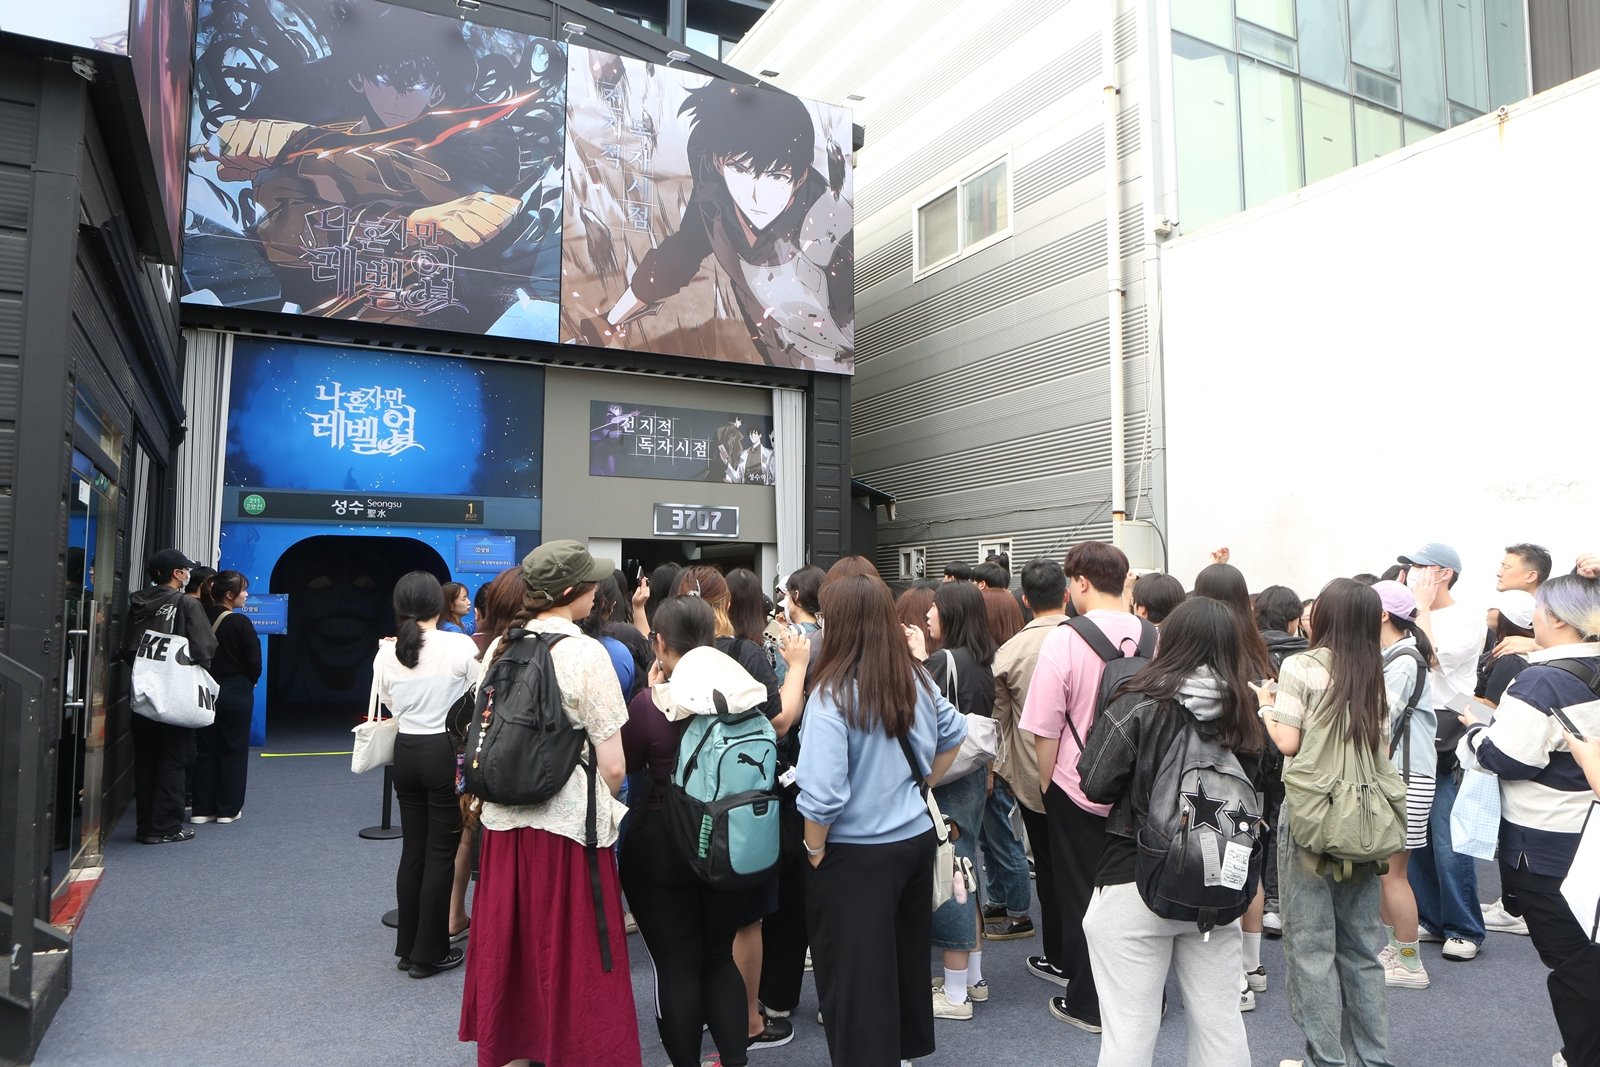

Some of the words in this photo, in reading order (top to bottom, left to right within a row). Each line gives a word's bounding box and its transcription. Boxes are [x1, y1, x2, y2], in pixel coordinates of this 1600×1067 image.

[599, 88, 623, 169] 전지적
[314, 205, 359, 247] 나
[355, 215, 443, 252] 혼자만
[300, 244, 469, 316] 레벨업
[315, 381, 347, 411] 나
[343, 385, 406, 414] 혼자만
[305, 404, 425, 457] 레벨업
[331, 499, 364, 515] 성수
[367, 499, 402, 509] Seongsu
[367, 509, 387, 518] 聖水
[467, 502, 473, 514] 1
[672, 509, 722, 531] 3707
[698, 814, 713, 858] PUMA
